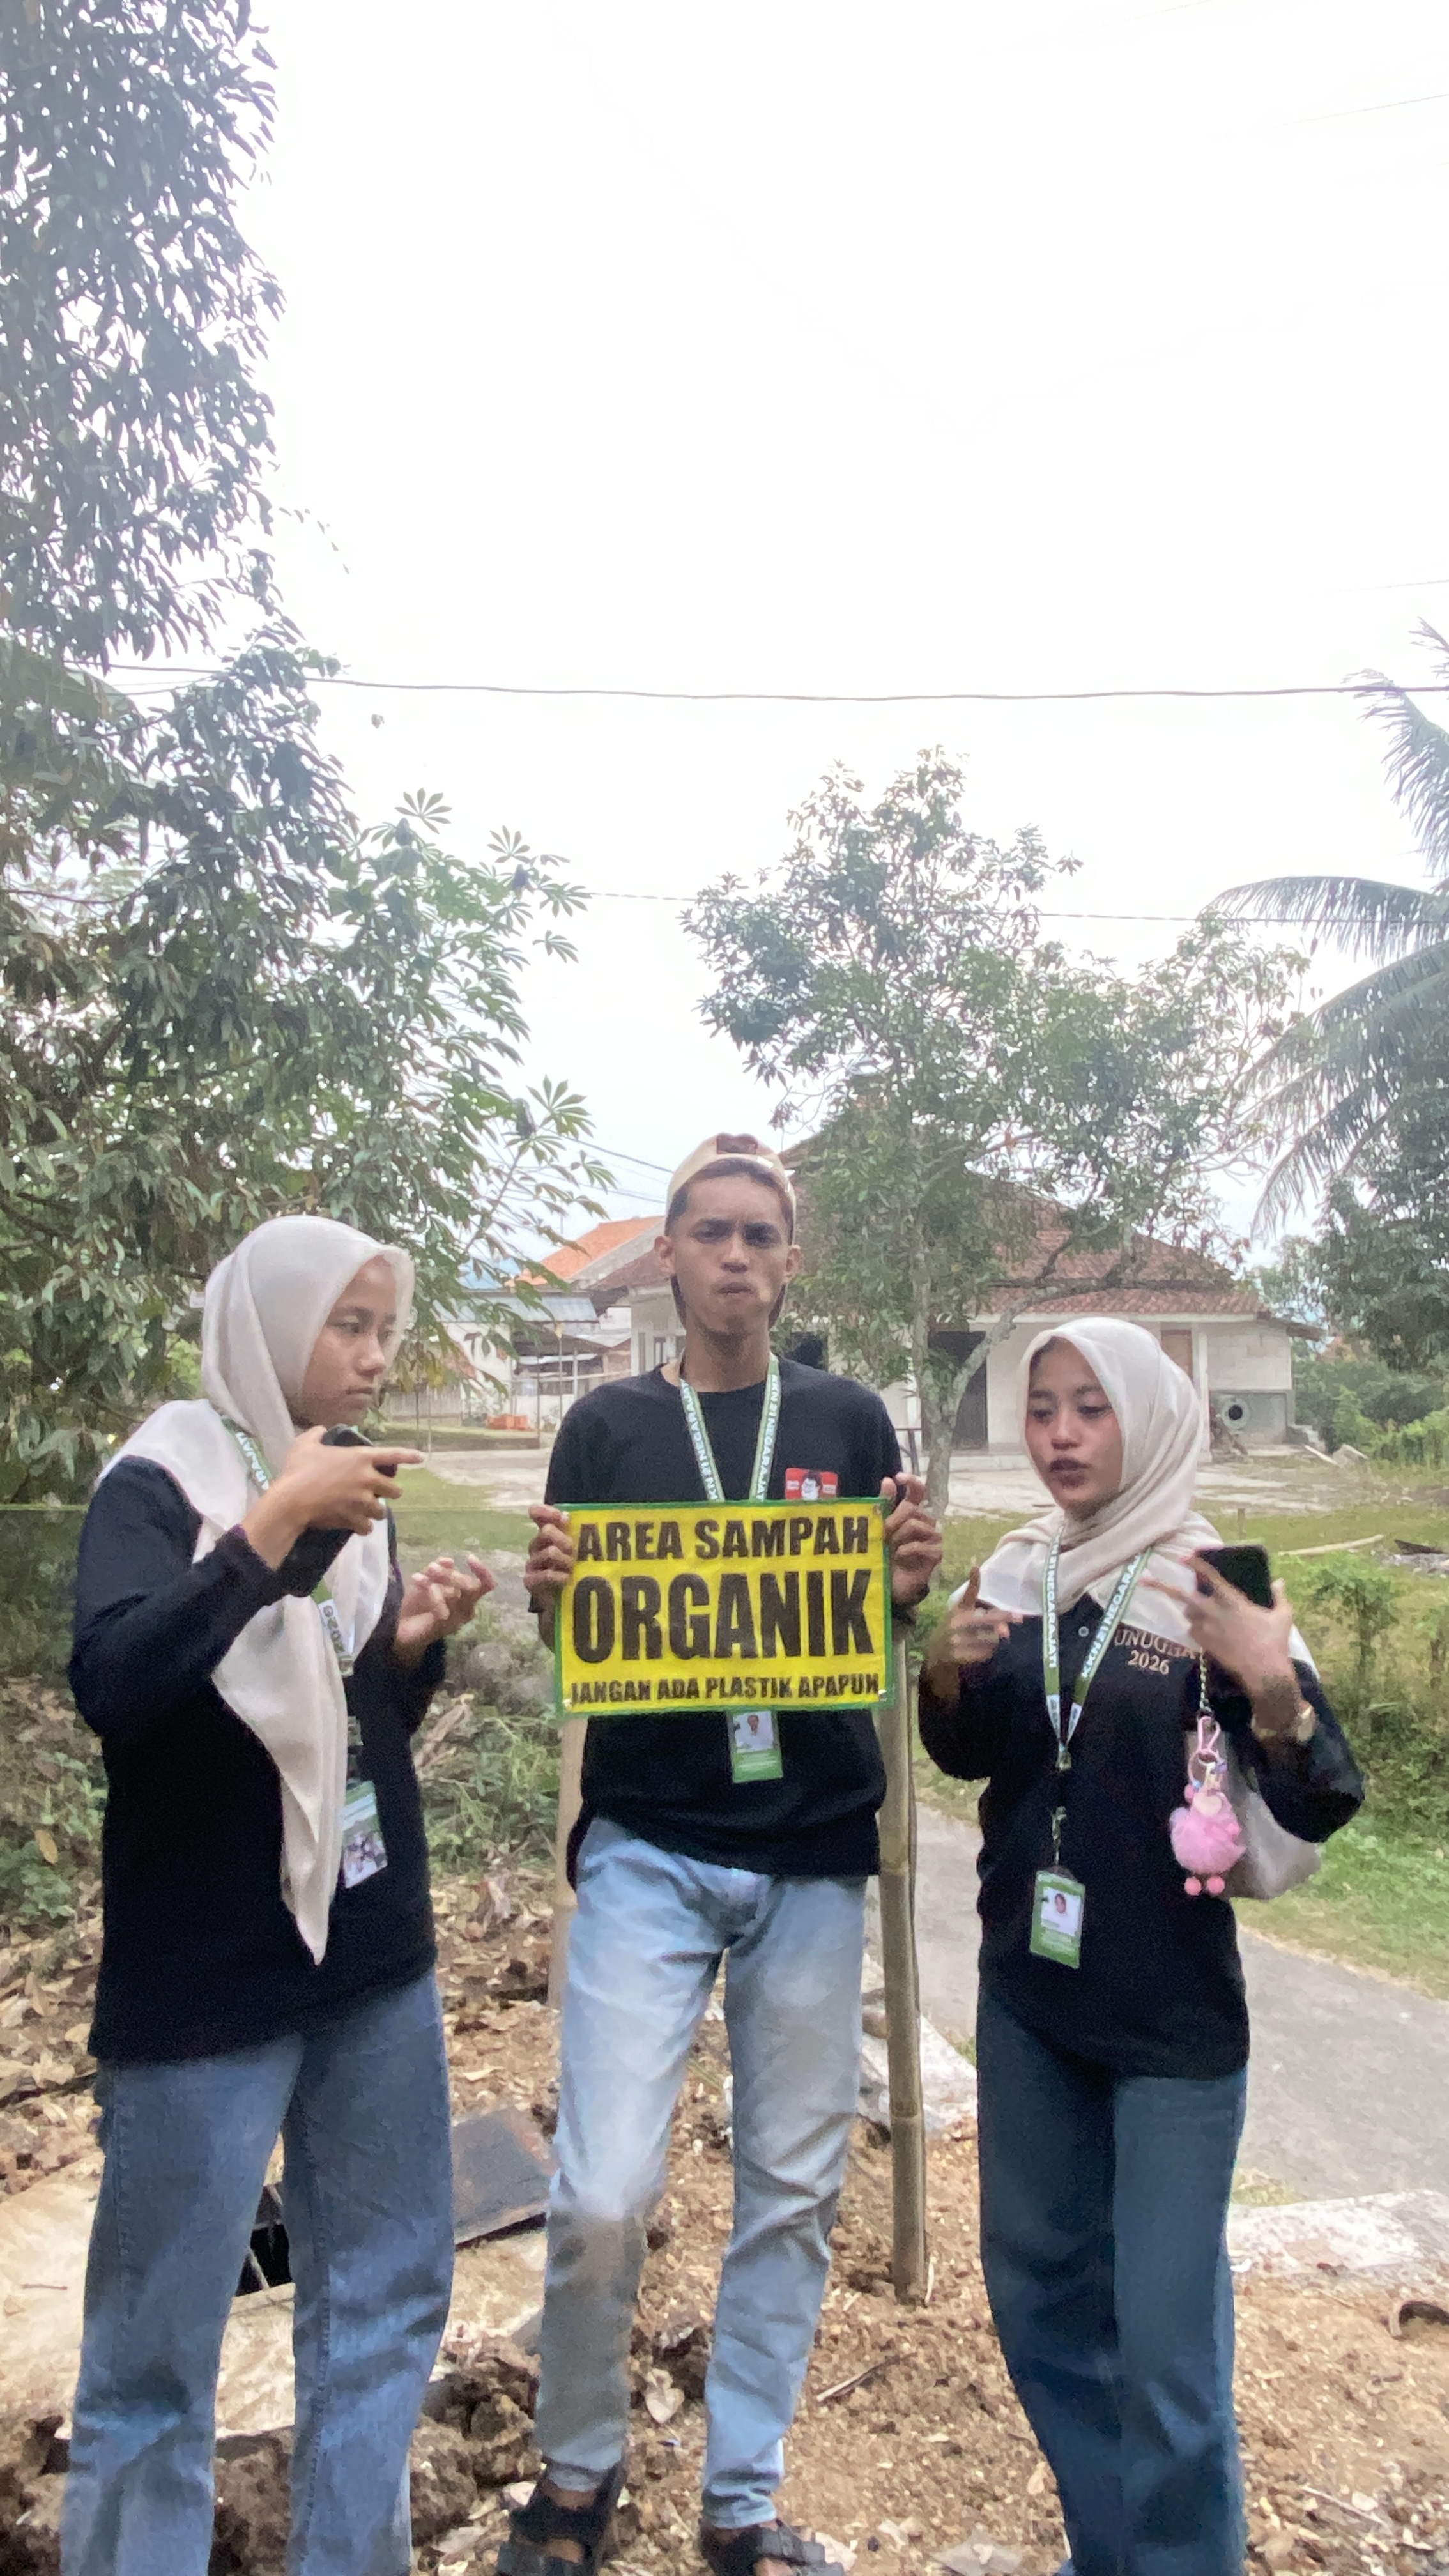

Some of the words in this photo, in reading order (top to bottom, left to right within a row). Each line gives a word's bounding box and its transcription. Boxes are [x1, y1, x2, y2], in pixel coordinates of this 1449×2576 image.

[576, 1521, 683, 1561] AREA
[694, 1516, 869, 1560] SAMPAH
[572, 1569, 874, 1663] ORGANIK
[1081, 1640, 1102, 1678] KKN
[1128, 1650, 1170, 1675] 2026
[571, 1679, 651, 1704] JANGAN
[657, 1678, 700, 1700] ADA
[705, 1676, 793, 1699] PLASTIK
[798, 1673, 880, 1698] APAPUN
